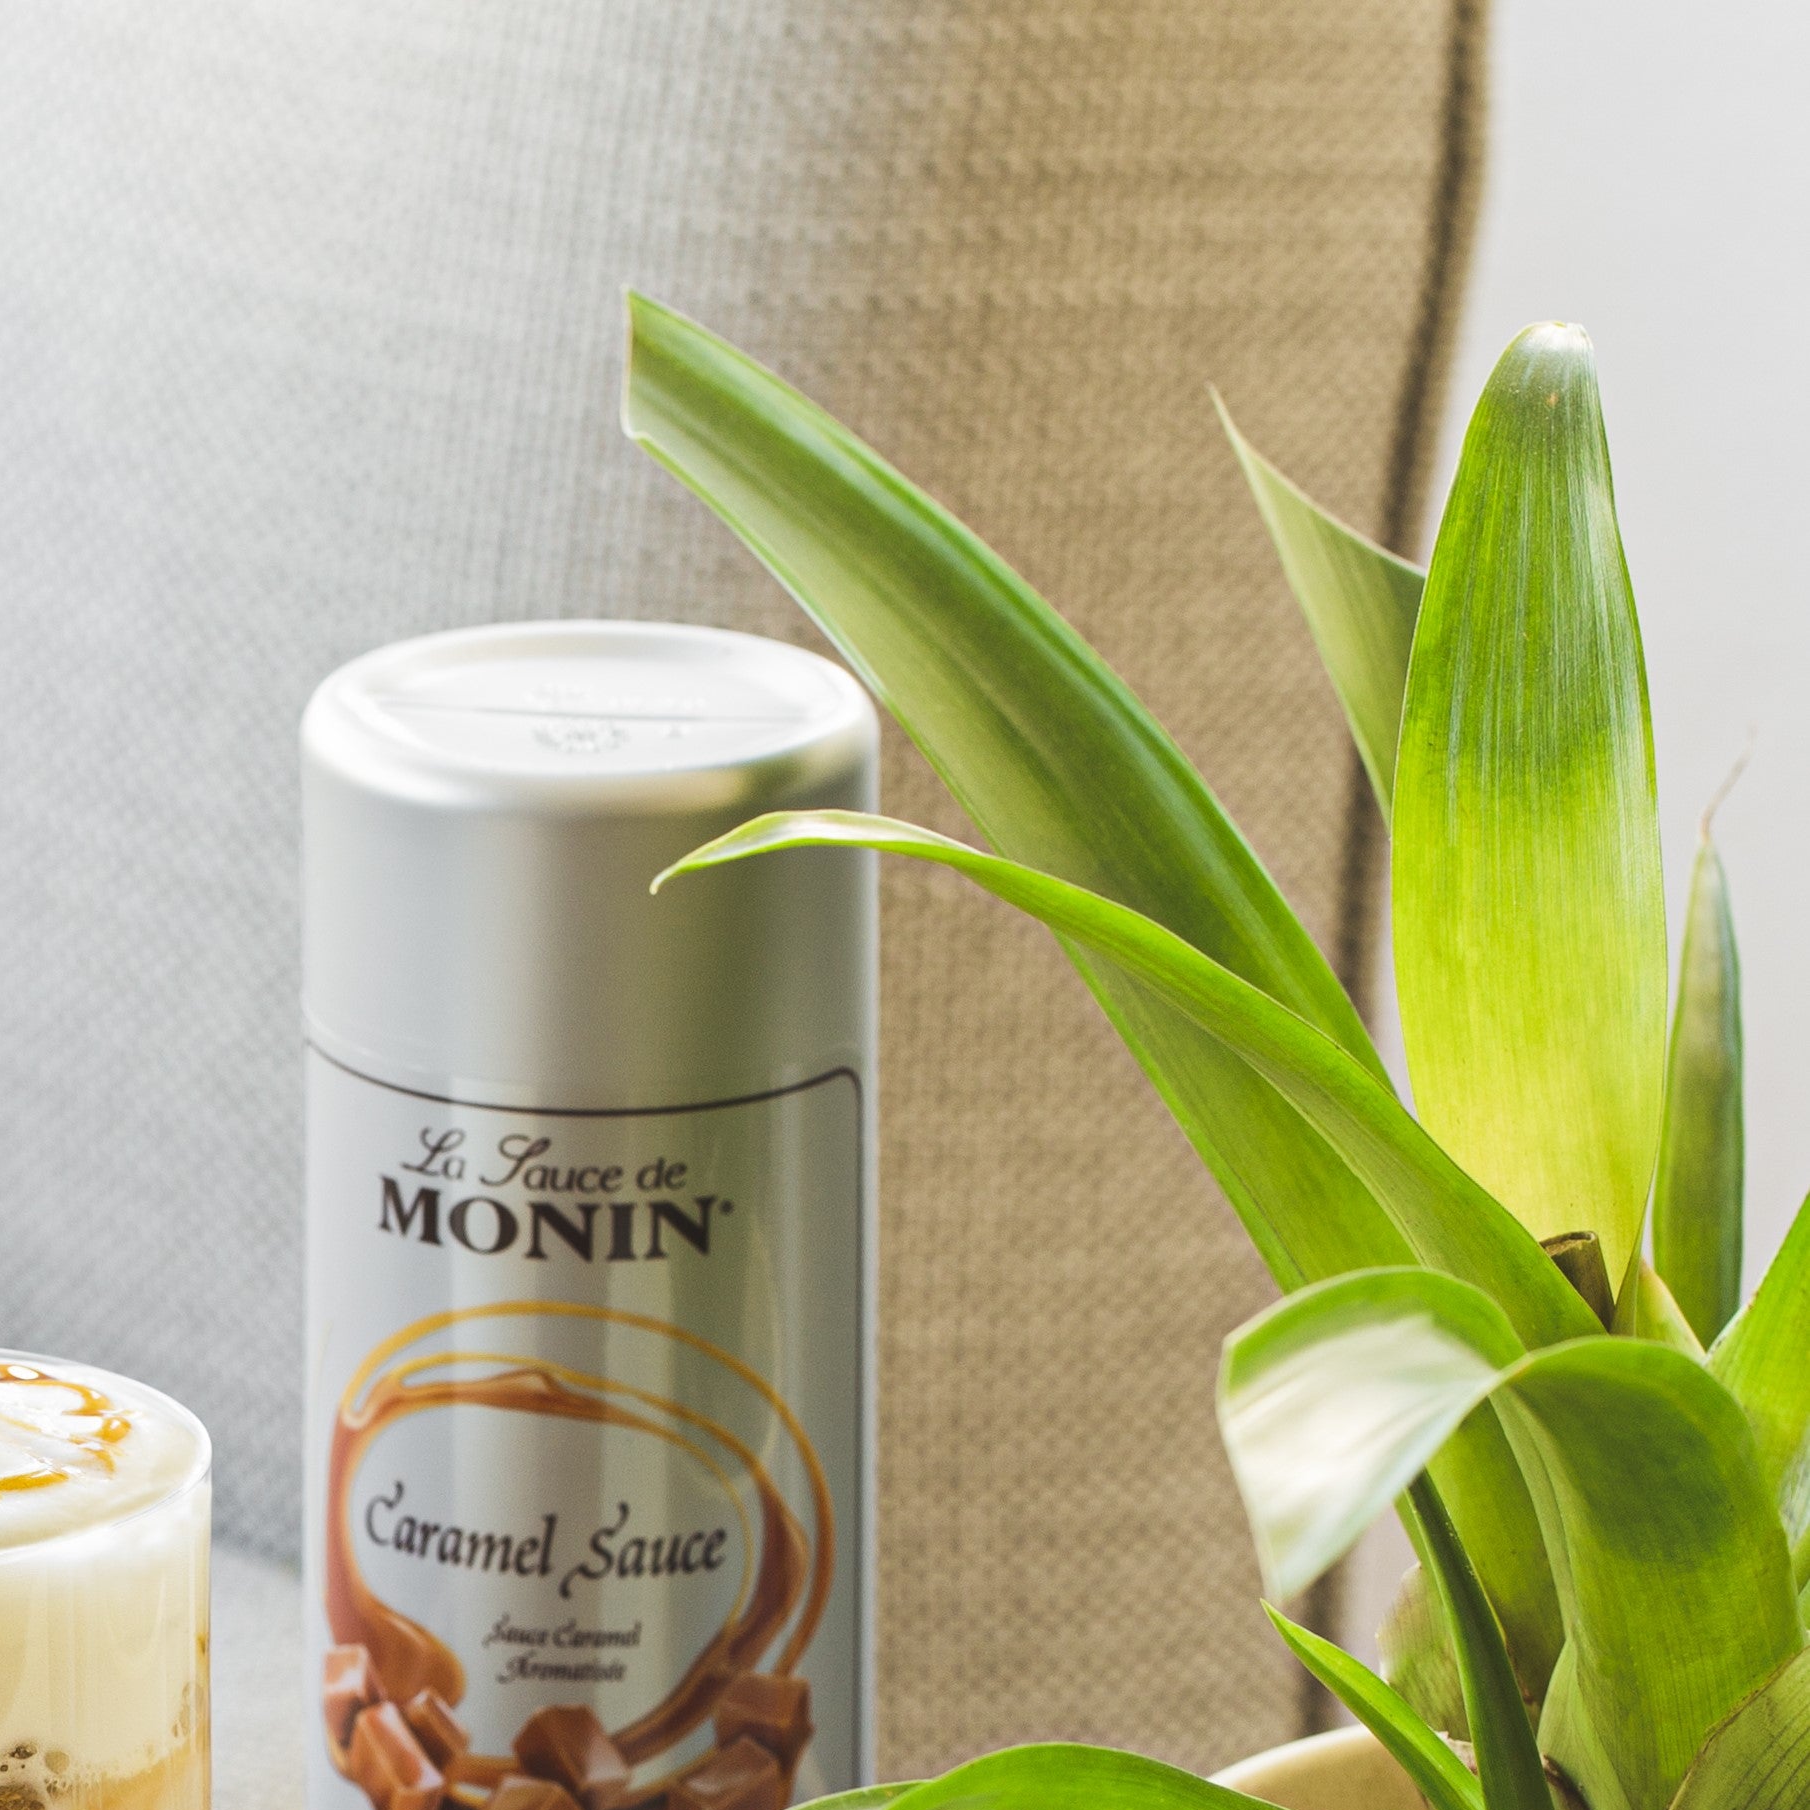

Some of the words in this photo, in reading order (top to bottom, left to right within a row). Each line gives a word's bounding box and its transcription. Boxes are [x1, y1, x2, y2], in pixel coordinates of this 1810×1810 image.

[401, 1126, 466, 1180] La
[480, 1133, 623, 1194] Sauce
[635, 1156, 689, 1190] de
[377, 1174, 719, 1263] MONIN
[365, 1481, 557, 1577] Caramel
[558, 1502, 728, 1600] Sauce
